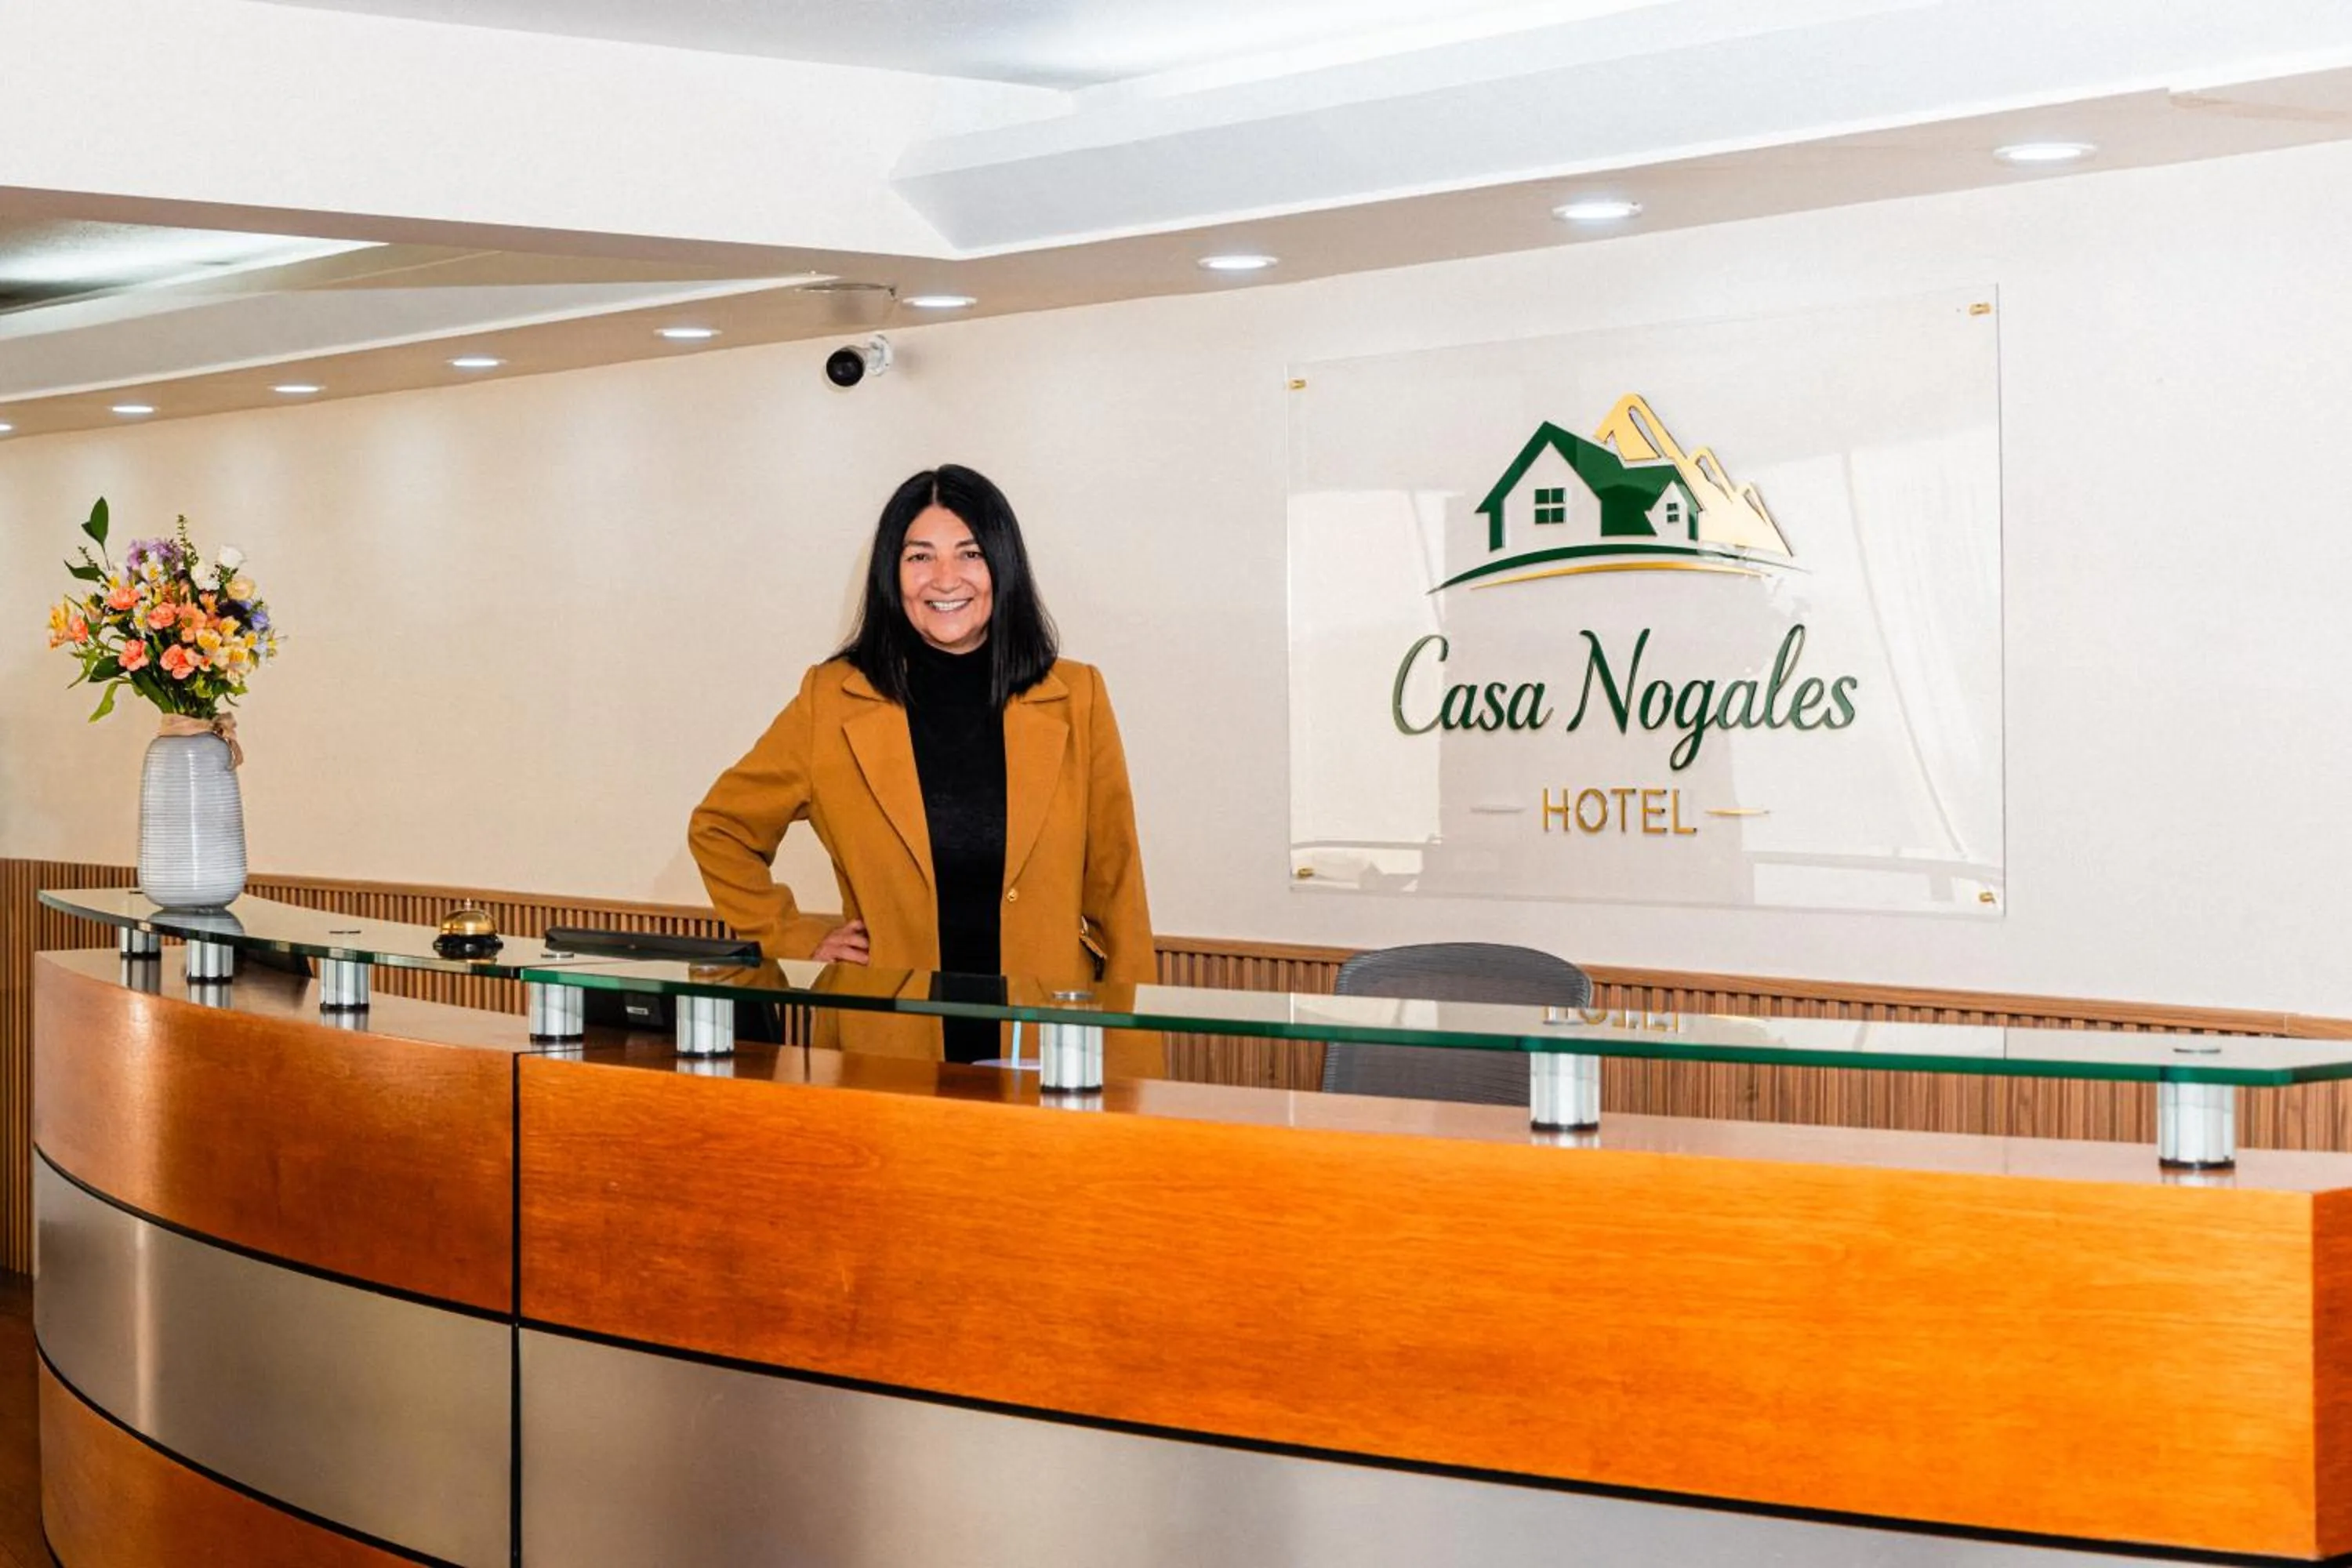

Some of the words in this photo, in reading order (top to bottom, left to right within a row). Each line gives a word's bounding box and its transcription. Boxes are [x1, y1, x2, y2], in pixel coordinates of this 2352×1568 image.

[1392, 634, 1554, 735] Casa
[1566, 623, 1858, 771] Nogales
[1542, 787, 1698, 835] HOTEL
